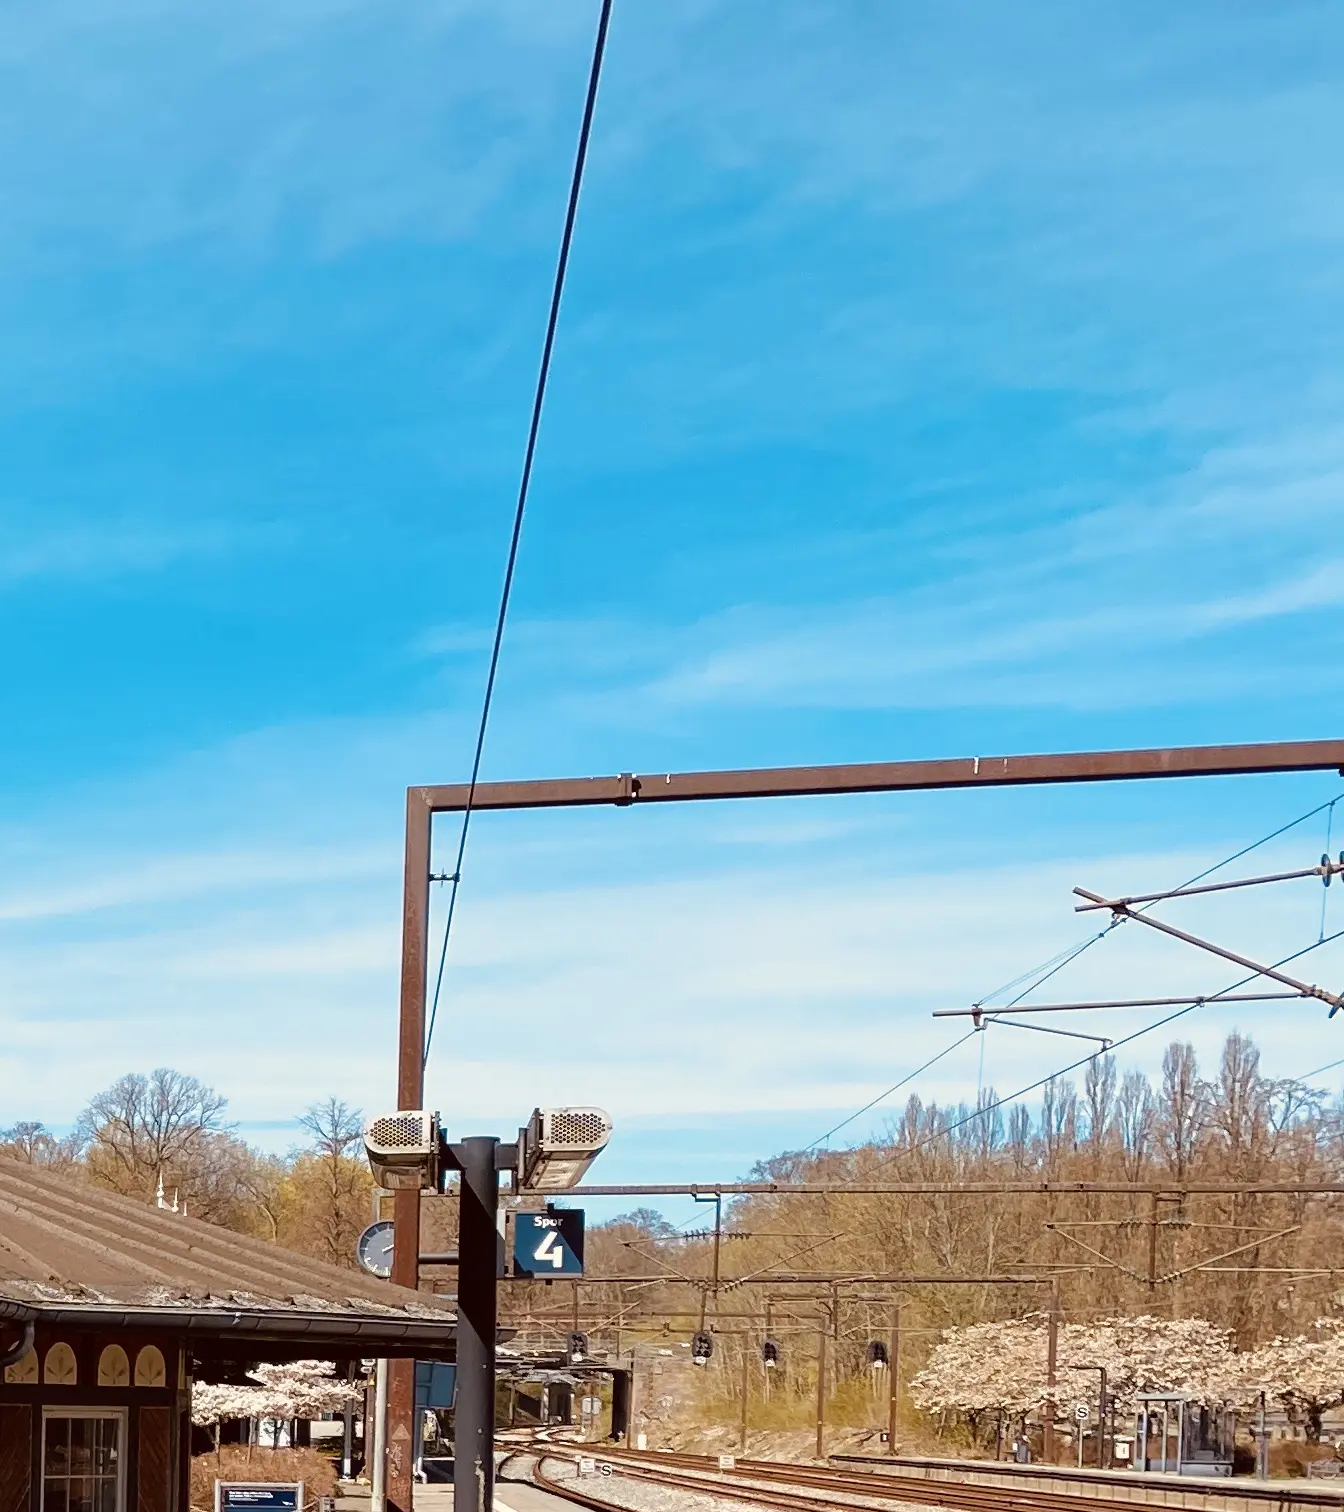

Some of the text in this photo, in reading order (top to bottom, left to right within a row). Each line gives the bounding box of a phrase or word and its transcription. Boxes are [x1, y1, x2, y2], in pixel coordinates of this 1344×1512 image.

[534, 1215, 563, 1228] Spor
[534, 1231, 563, 1268] 4
[1076, 1407, 1088, 1418] S
[602, 1465, 612, 1477] S
